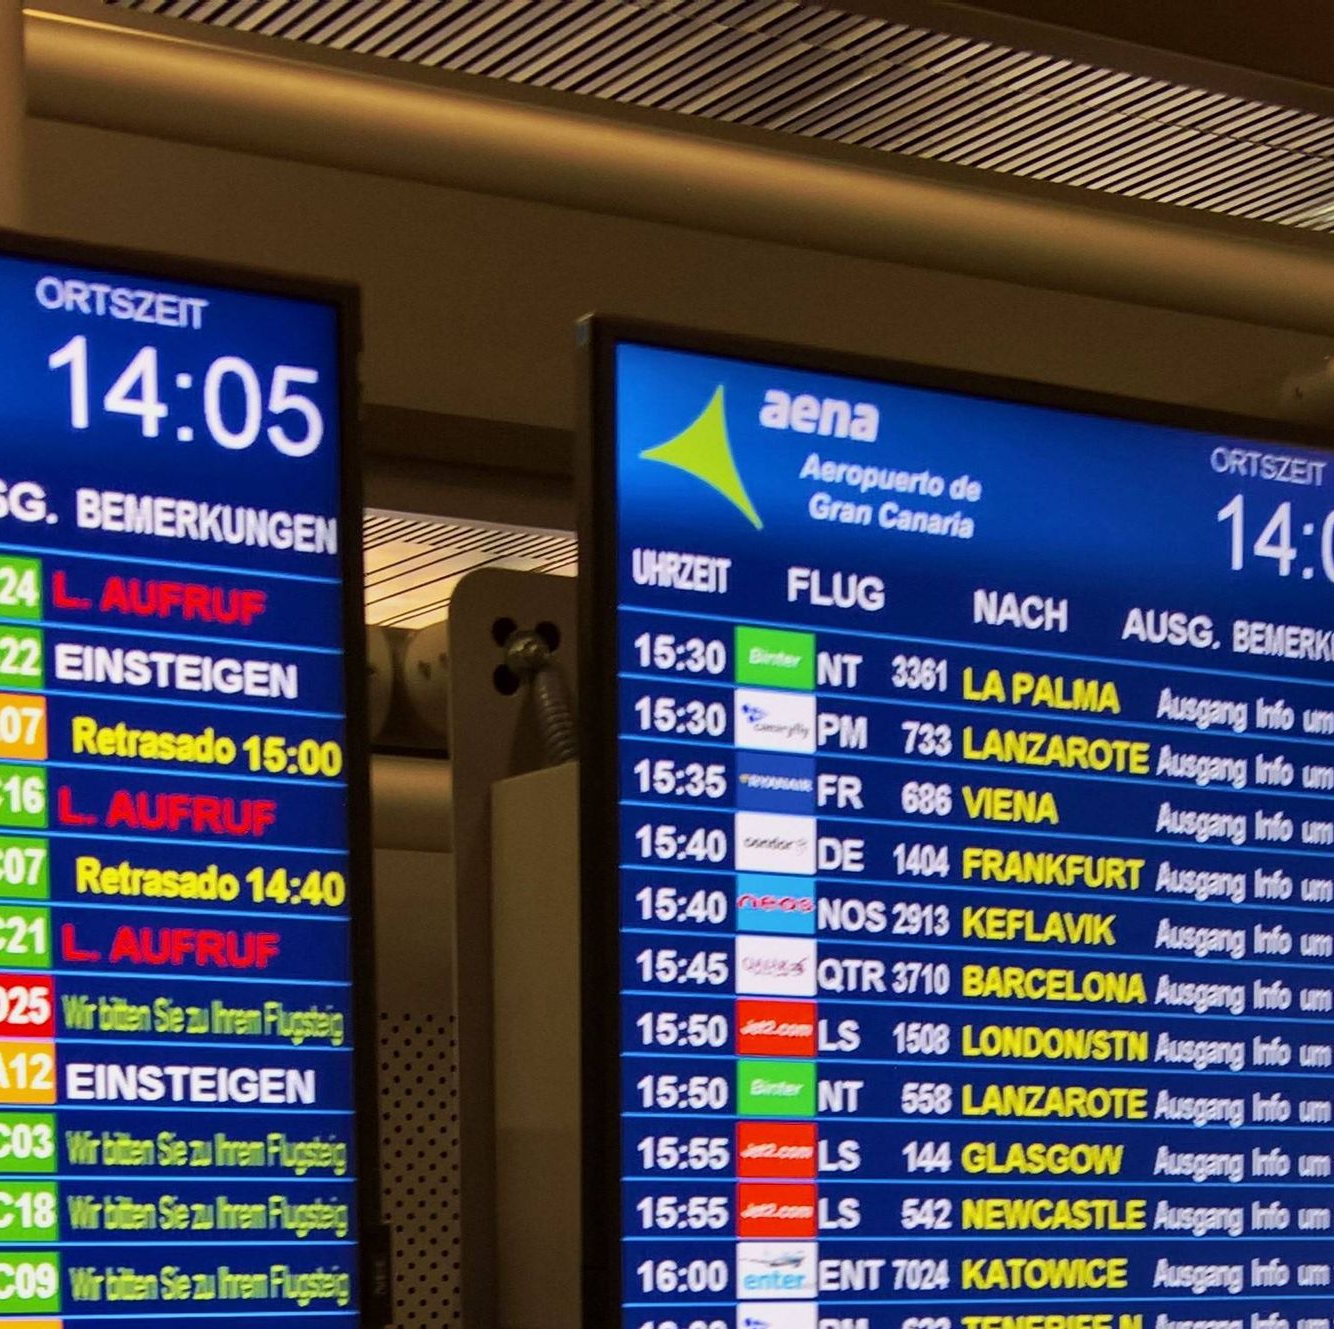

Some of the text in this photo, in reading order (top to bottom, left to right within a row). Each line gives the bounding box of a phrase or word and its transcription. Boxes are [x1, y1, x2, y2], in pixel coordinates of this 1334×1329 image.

[35, 275, 209, 330] ORTSZEIT
[47, 334, 324, 458] 14:05
[758, 388, 880, 443] aena
[799, 452, 982, 503] Aeropuerto de
[1210, 446, 1328, 487] ORTSZEIT
[75, 487, 338, 555] BEMERKUNGEN
[808, 491, 975, 540] Gran Canaria
[51, 570, 92, 610] L.
[99, 575, 266, 626] AUFRUF
[631, 547, 732, 594] UHRZEIT
[787, 565, 886, 612] FLUG
[973, 588, 1069, 633] NACH
[1120, 606, 1221, 651] AUSG.
[53, 642, 298, 696] EINSTEIGEN
[75, 855, 241, 902] Retrasado
[245, 866, 346, 907] 14:40
[635, 948, 729, 986] 15:45
[817, 957, 887, 994] QTR
[890, 960, 951, 996] 3710
[961, 963, 1148, 1005] BARCELONA
[1153, 973, 1246, 1016] Ausgang
[1252, 978, 1293, 1011] Info
[1299, 988, 1334, 1013] um
[65, 1062, 316, 1102] EINSTEIGEN
[637, 1135, 731, 1171] 15:55
[817, 1139, 861, 1173] LS
[901, 1140, 953, 1174] 144
[960, 1141, 1125, 1176] GLASGOW
[1152, 1144, 1245, 1183] Ausgang
[1251, 1146, 1292, 1178] Info
[1297, 1154, 1332, 1178] um
